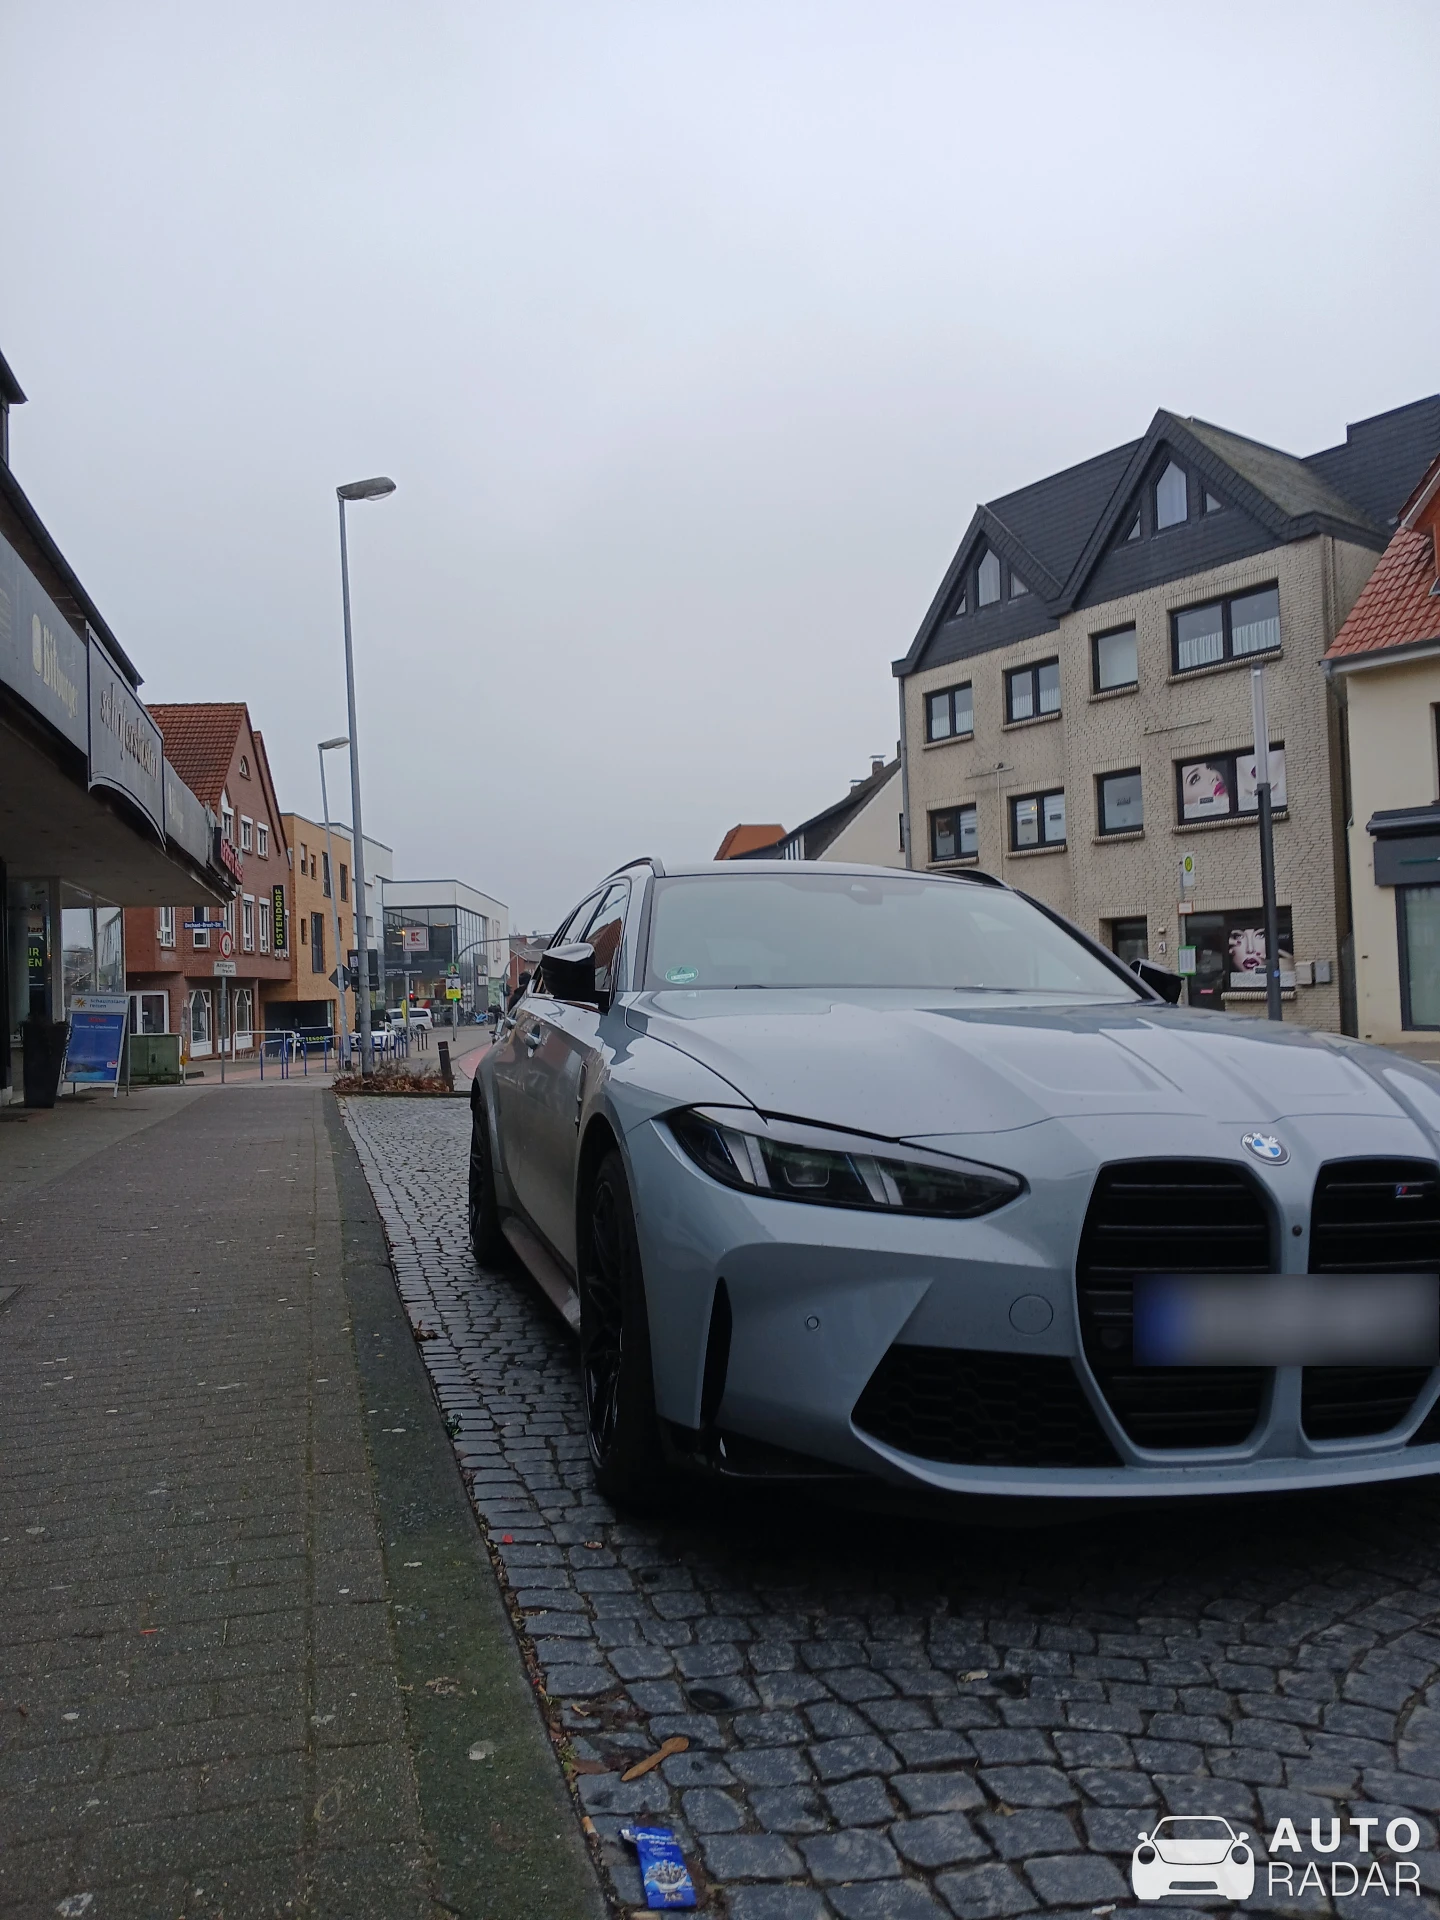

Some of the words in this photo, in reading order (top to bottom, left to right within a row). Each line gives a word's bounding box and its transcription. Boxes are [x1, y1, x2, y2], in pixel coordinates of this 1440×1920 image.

[43, 624, 78, 719] Bitburger
[275, 888, 284, 946] OSTENDORF
[1244, 1132, 1279, 1144] BMW
